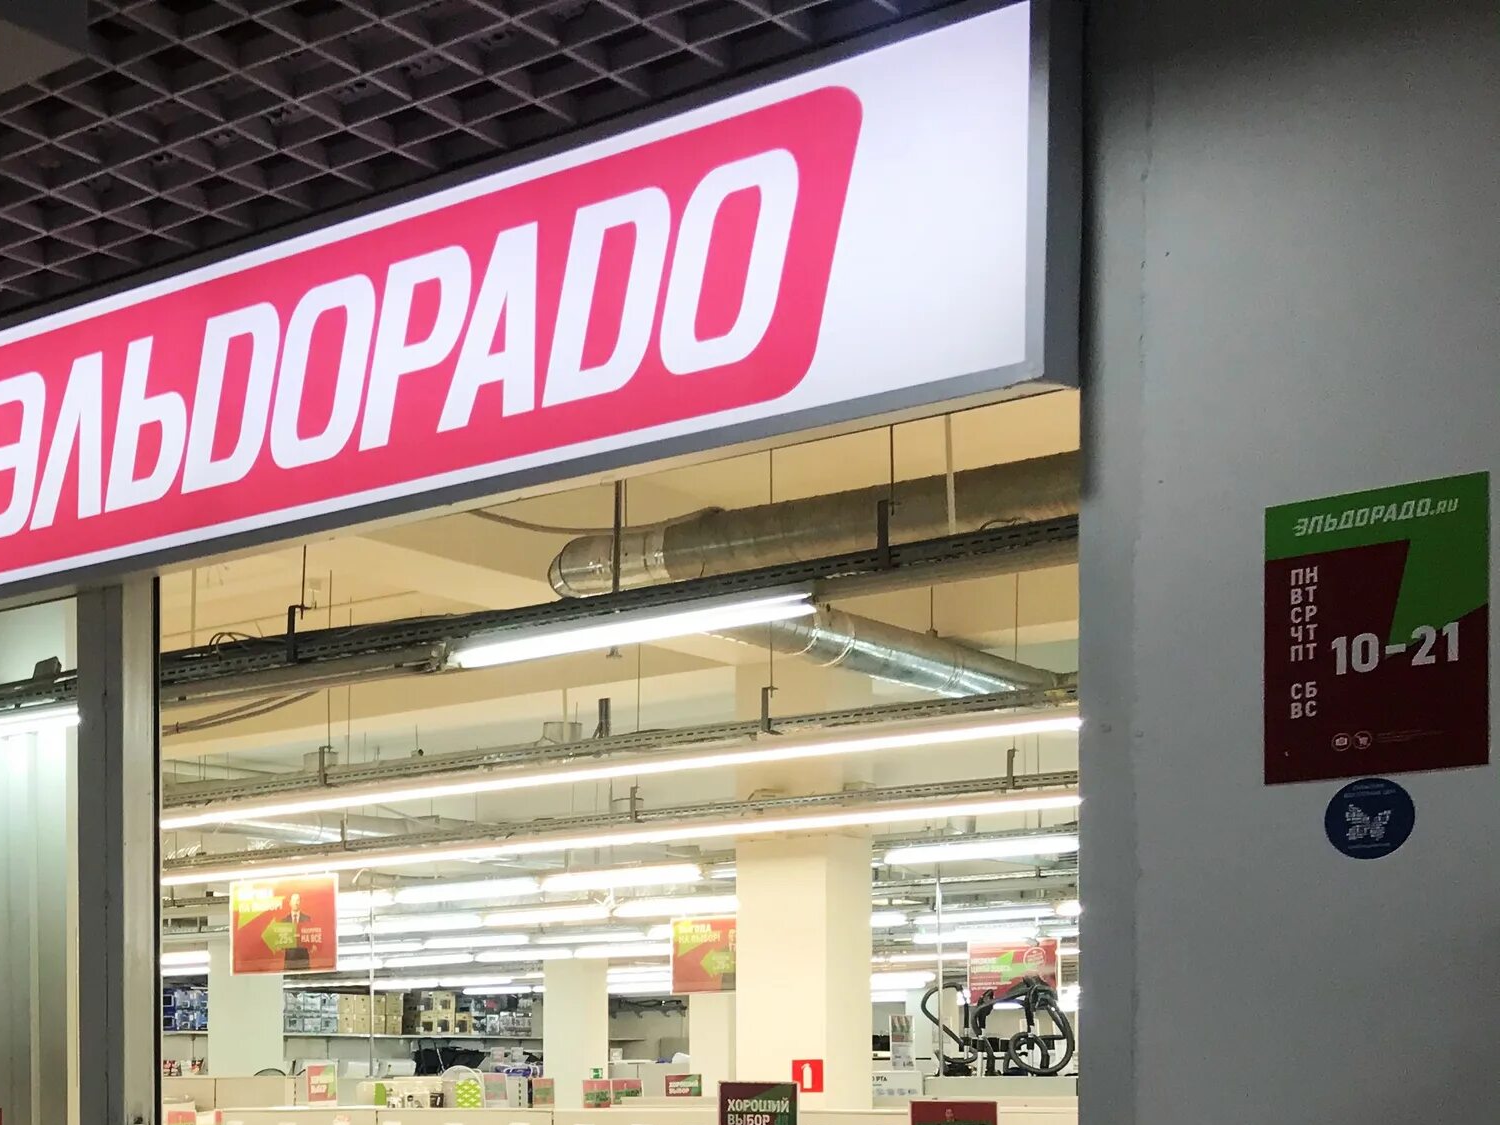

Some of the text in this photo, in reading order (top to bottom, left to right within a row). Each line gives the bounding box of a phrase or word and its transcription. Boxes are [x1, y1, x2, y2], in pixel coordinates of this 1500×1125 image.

[1289, 566, 1318, 586] ПН
[1290, 586, 1317, 605] ВТ
[1290, 605, 1317, 623] СР
[1290, 623, 1318, 642] ЧТ
[1290, 642, 1317, 662] ПТ
[1290, 681, 1318, 700] СБ
[1290, 700, 1318, 719] ВС
[727, 1097, 790, 1113] ХОРОШИЙ
